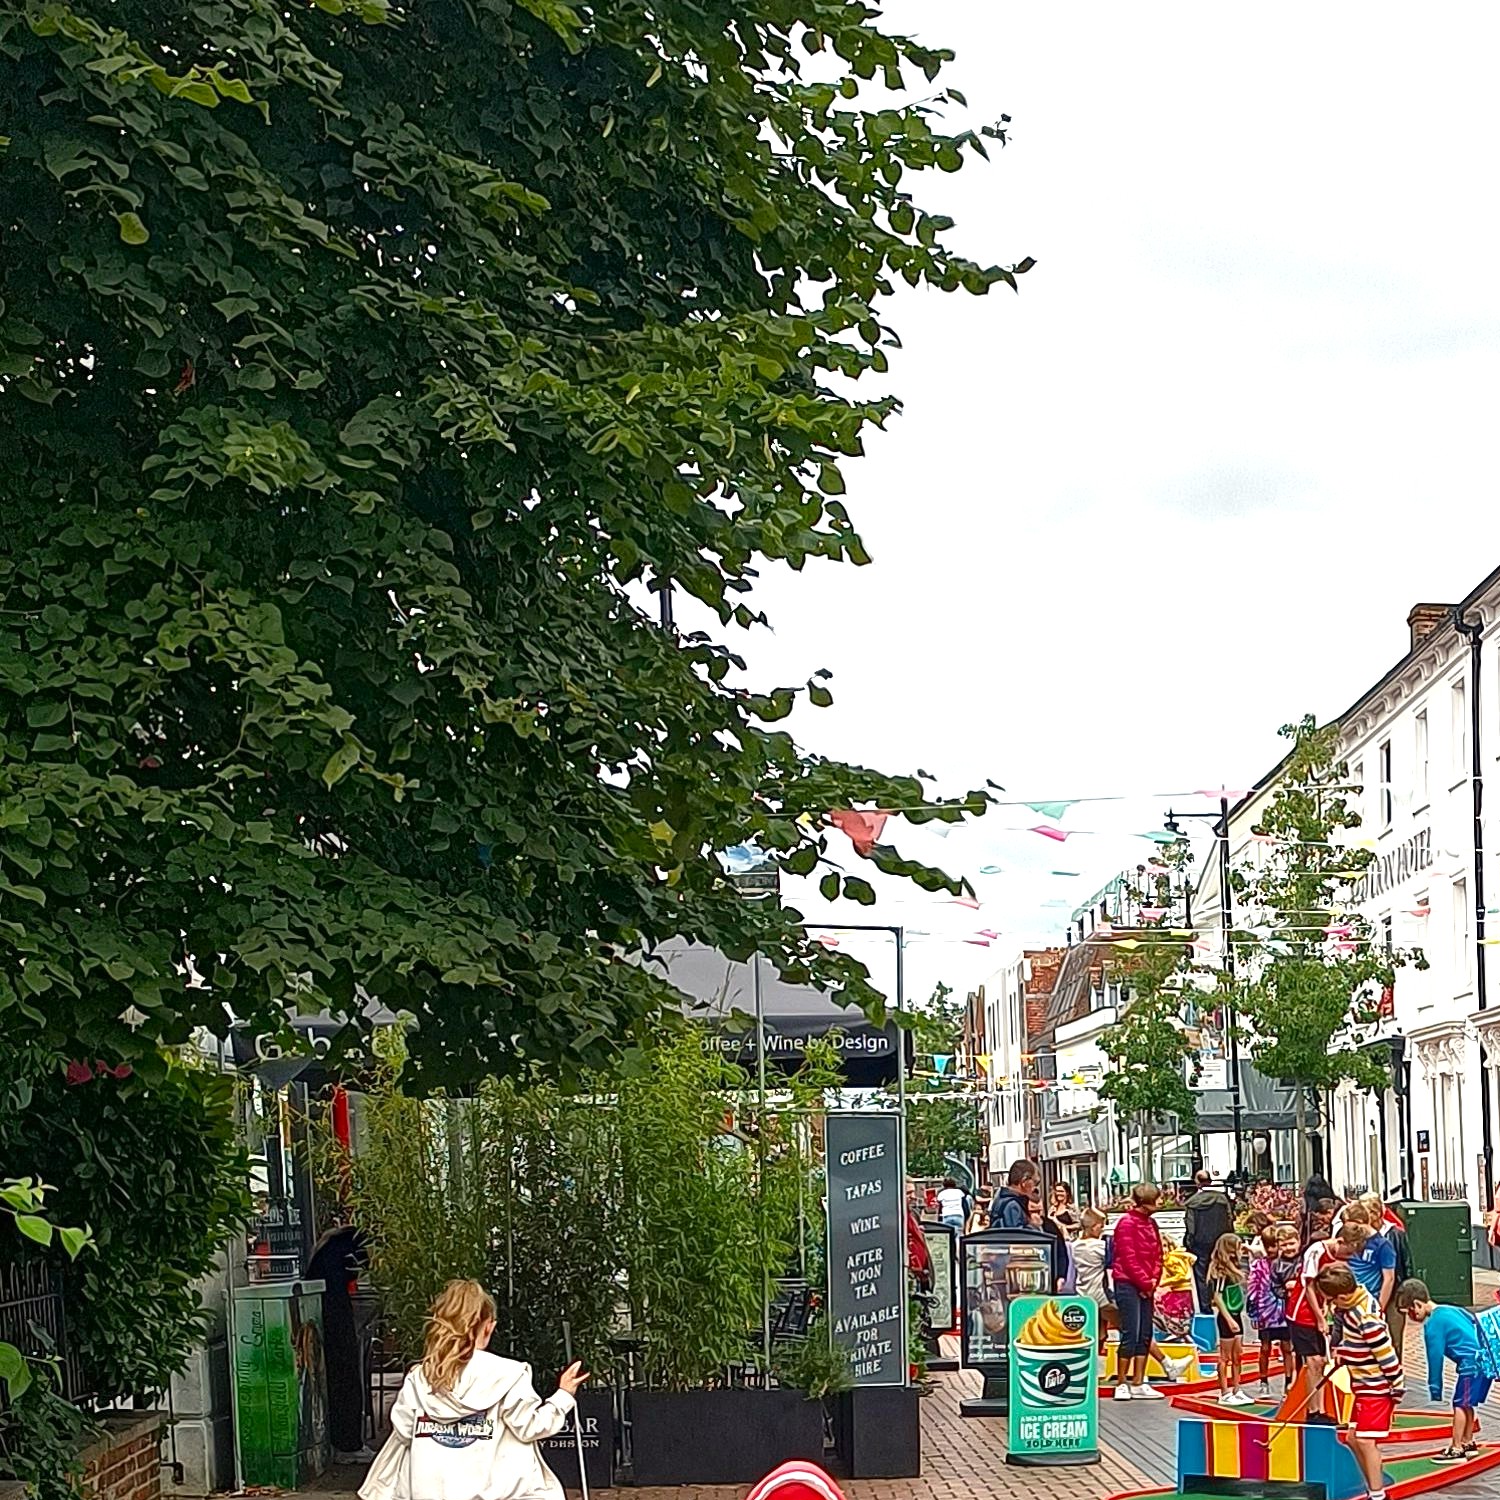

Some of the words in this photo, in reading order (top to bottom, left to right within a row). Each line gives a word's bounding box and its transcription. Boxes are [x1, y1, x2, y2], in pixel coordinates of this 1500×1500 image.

[699, 1036, 741, 1051] offee
[763, 1035, 806, 1051] Wine
[832, 1033, 888, 1053] Design
[840, 1144, 885, 1165] COFFEE
[845, 1180, 882, 1200] TAPAS
[850, 1216, 880, 1235] WINE
[847, 1248, 883, 1269] AFTER
[850, 1264, 882, 1284] NOON
[855, 1282, 877, 1299] TEA
[834, 1305, 899, 1334] AVAILABLE
[857, 1328, 878, 1344] FOR
[848, 1340, 892, 1362] RIVATE
[1020, 1422, 1040, 1440] ICE
[1043, 1420, 1088, 1439] CREAM
[549, 1439, 600, 1449] DESGN
